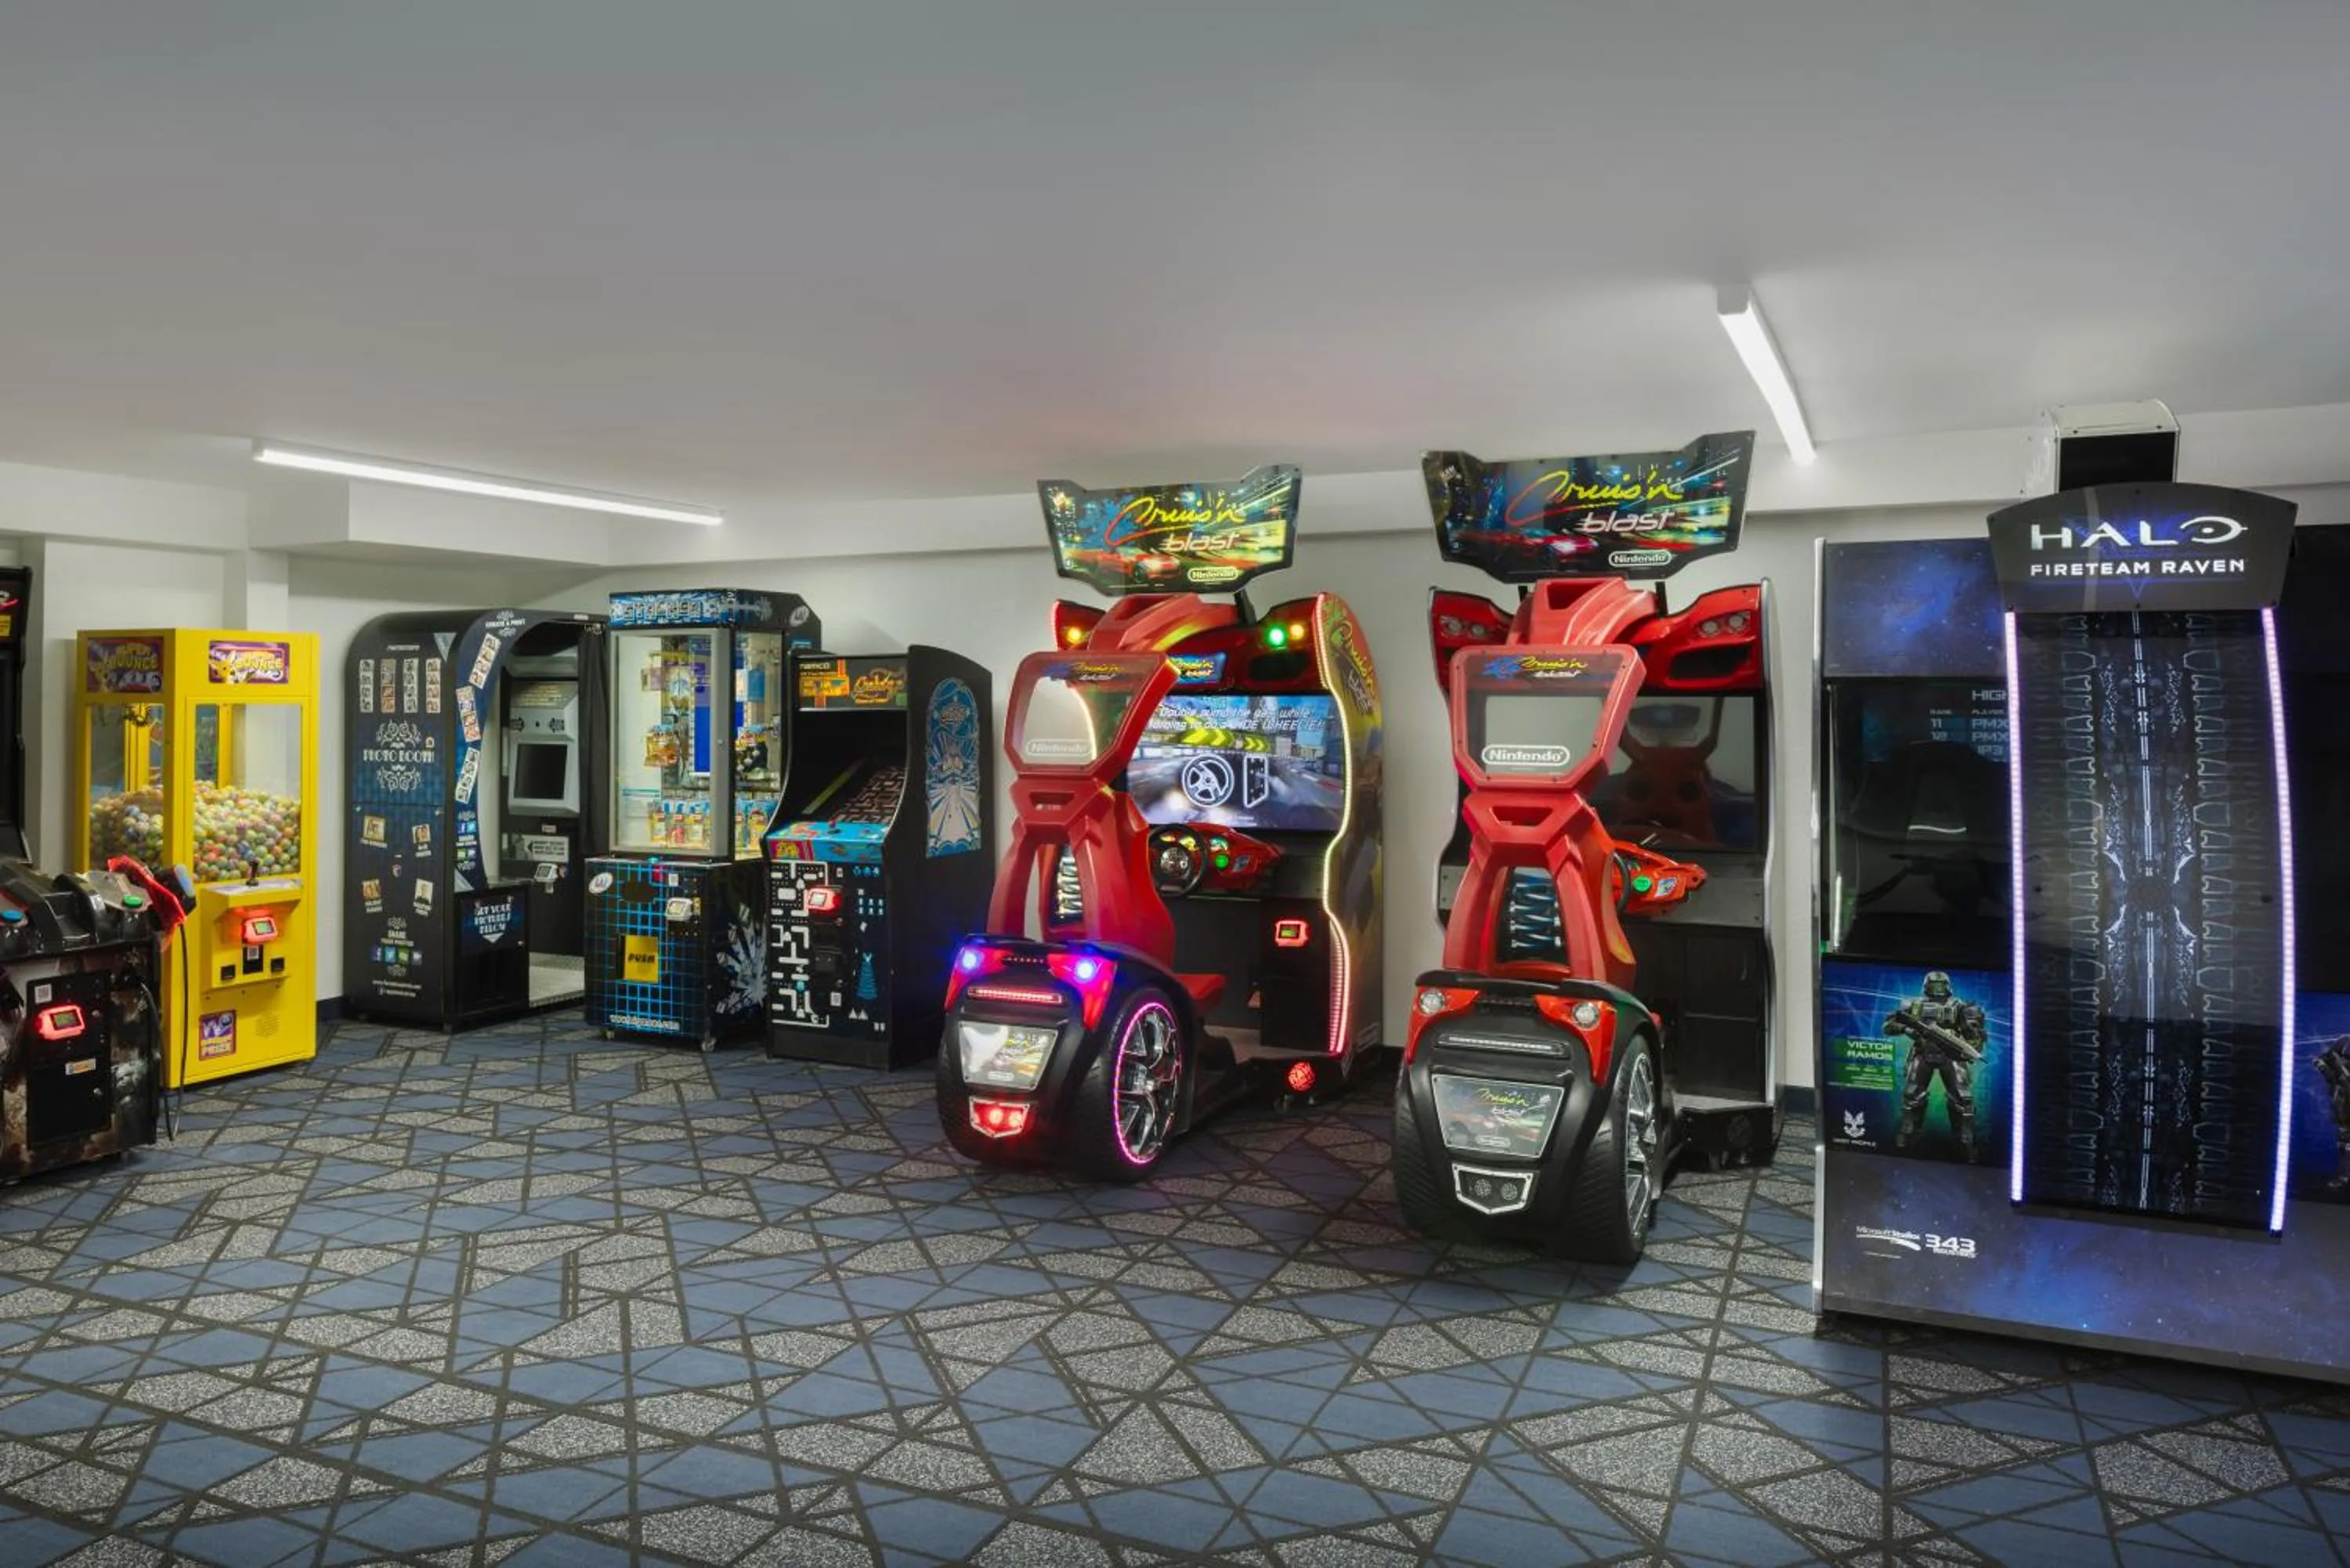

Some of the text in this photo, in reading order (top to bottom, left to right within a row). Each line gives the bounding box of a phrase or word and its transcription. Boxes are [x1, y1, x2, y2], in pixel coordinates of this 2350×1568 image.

[1505, 470, 1683, 526] Cruis'n
[1104, 492, 1246, 547] Cruis'n
[1576, 510, 1679, 533] blast
[2031, 516, 2248, 550] HALO
[1162, 533, 1241, 551] blast
[1613, 552, 1668, 564] Nintendo
[2031, 559, 2245, 576] FIRETEAM RAVEN
[1489, 749, 1564, 763] Nintendo
[628, 952, 655, 963] PUSH
[1847, 1040, 1893, 1050] VICTOR
[1846, 1050, 1893, 1061] RAMOS
[1925, 1234, 1976, 1252] 343
